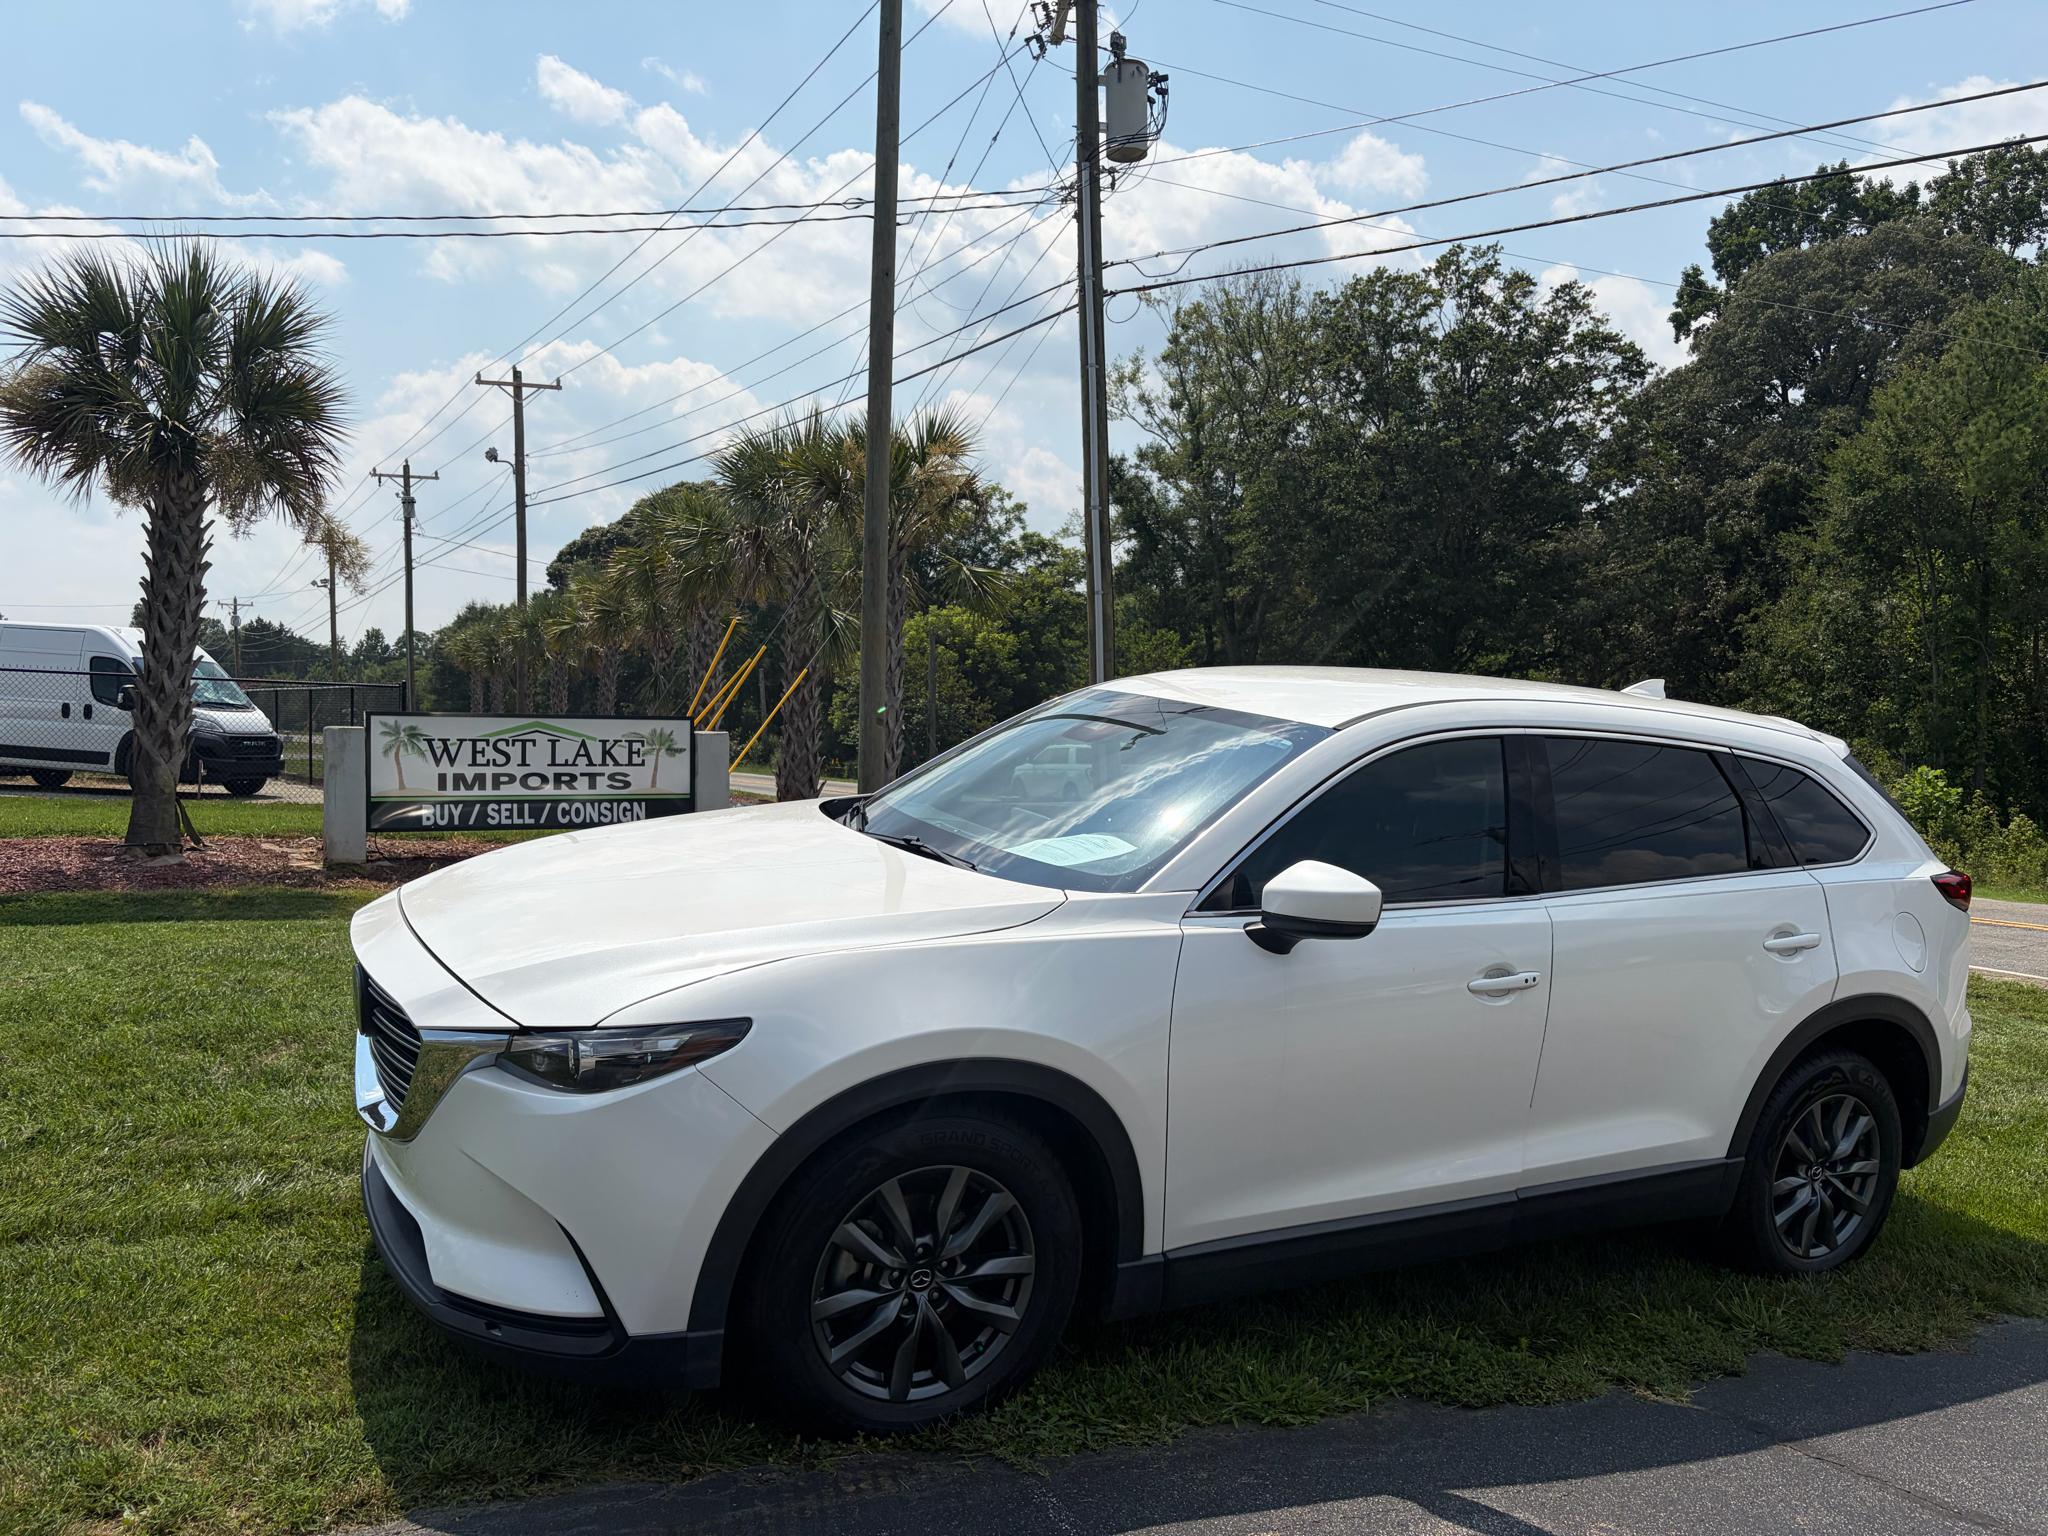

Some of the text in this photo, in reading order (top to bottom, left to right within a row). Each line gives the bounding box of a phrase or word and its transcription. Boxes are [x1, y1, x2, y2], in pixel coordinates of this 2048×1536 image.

[422, 738, 646, 768] WEST LAKE
[437, 772, 632, 792] IMPORTS
[422, 801, 646, 826] BUY / SELL / CONSIGN
[920, 1130, 986, 1147] GRAND
